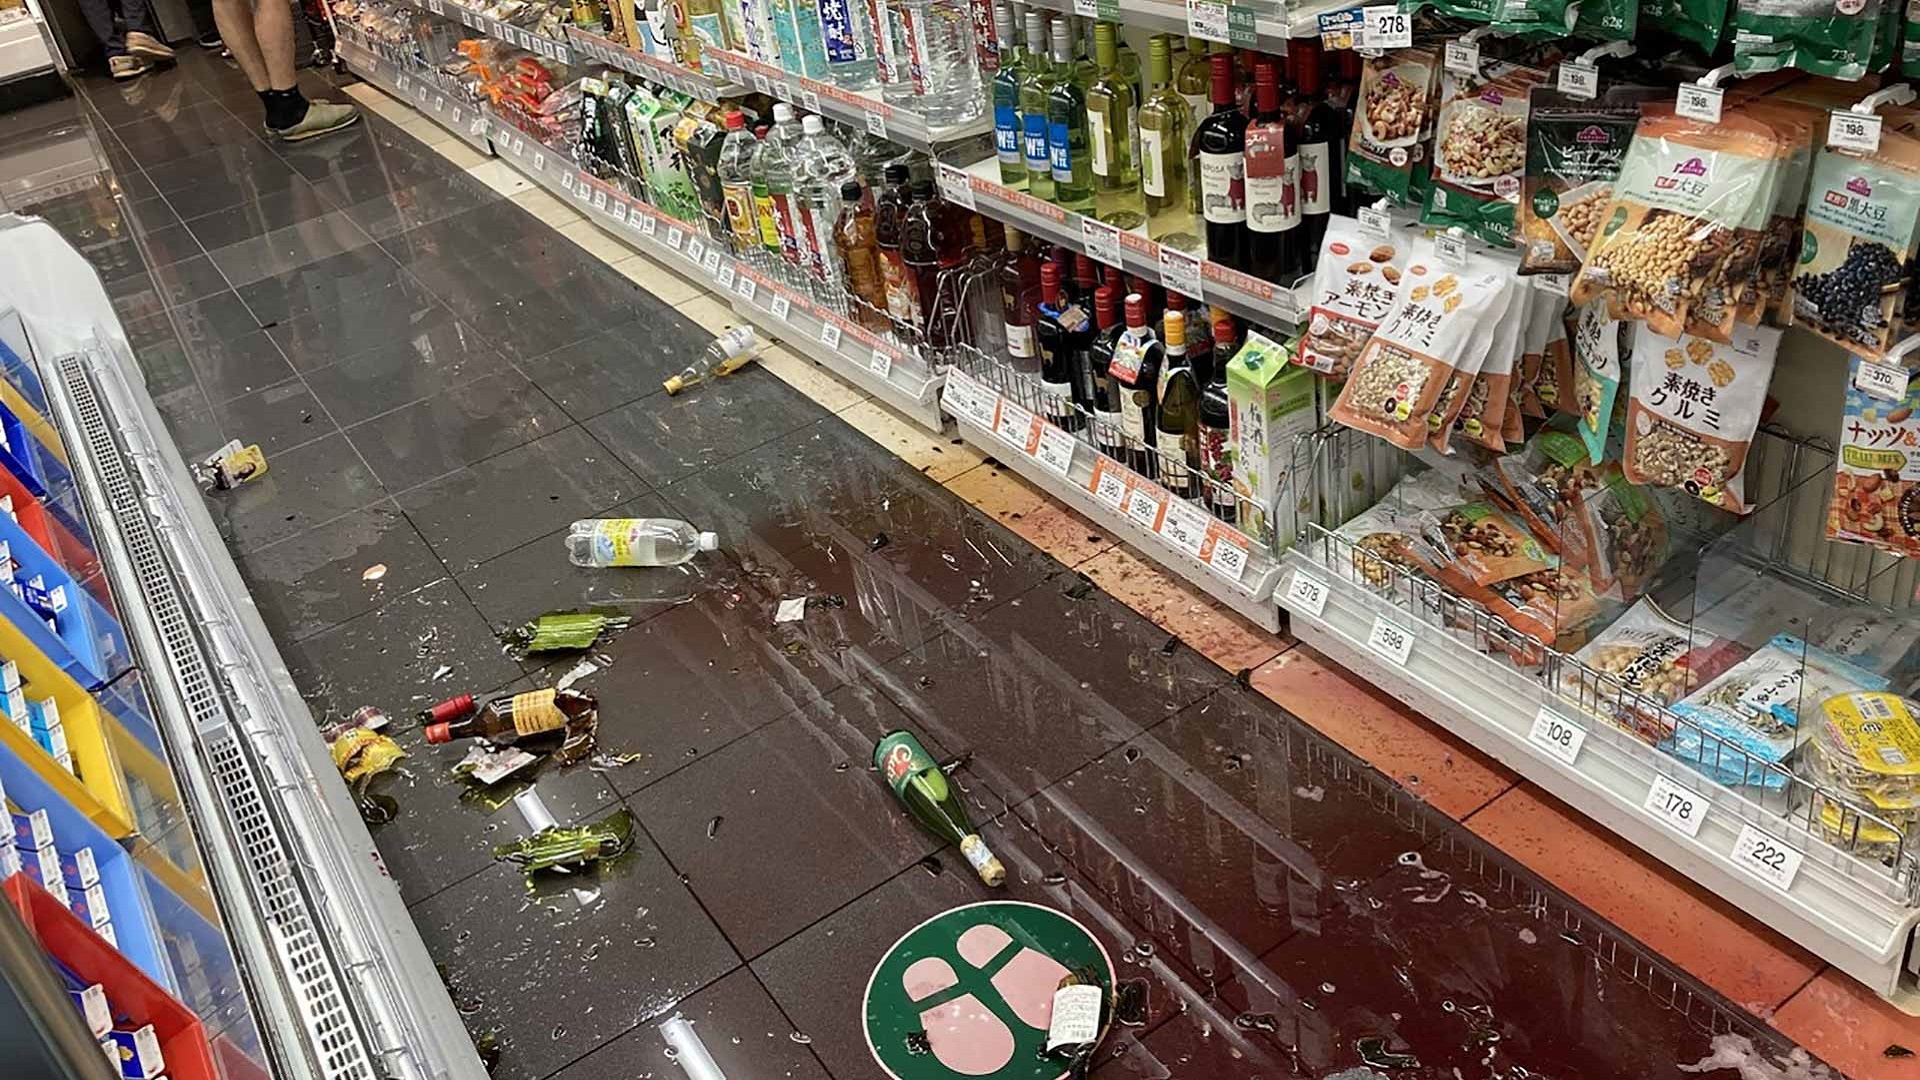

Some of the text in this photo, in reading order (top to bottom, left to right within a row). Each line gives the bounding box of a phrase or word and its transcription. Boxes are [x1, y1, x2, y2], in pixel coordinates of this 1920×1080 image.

[1379, 15, 1405, 34] 278
[1832, 49, 1857, 63] 73g
[1691, 95, 1707, 108] 198
[1846, 123, 1865, 136] 198
[1321, 290, 1391, 320] アーモン
[1872, 370, 1893, 384] 370
[1662, 371, 1717, 406] 素焼き
[1650, 387, 1720, 430] クルミ
[1137, 498, 1153, 517] 980
[1221, 548, 1240, 568] 828
[1299, 582, 1319, 602] 378
[1382, 630, 1403, 650] 598
[1546, 720, 1573, 747] 108
[1665, 791, 1693, 819] 178
[1752, 842, 1787, 871] 222
